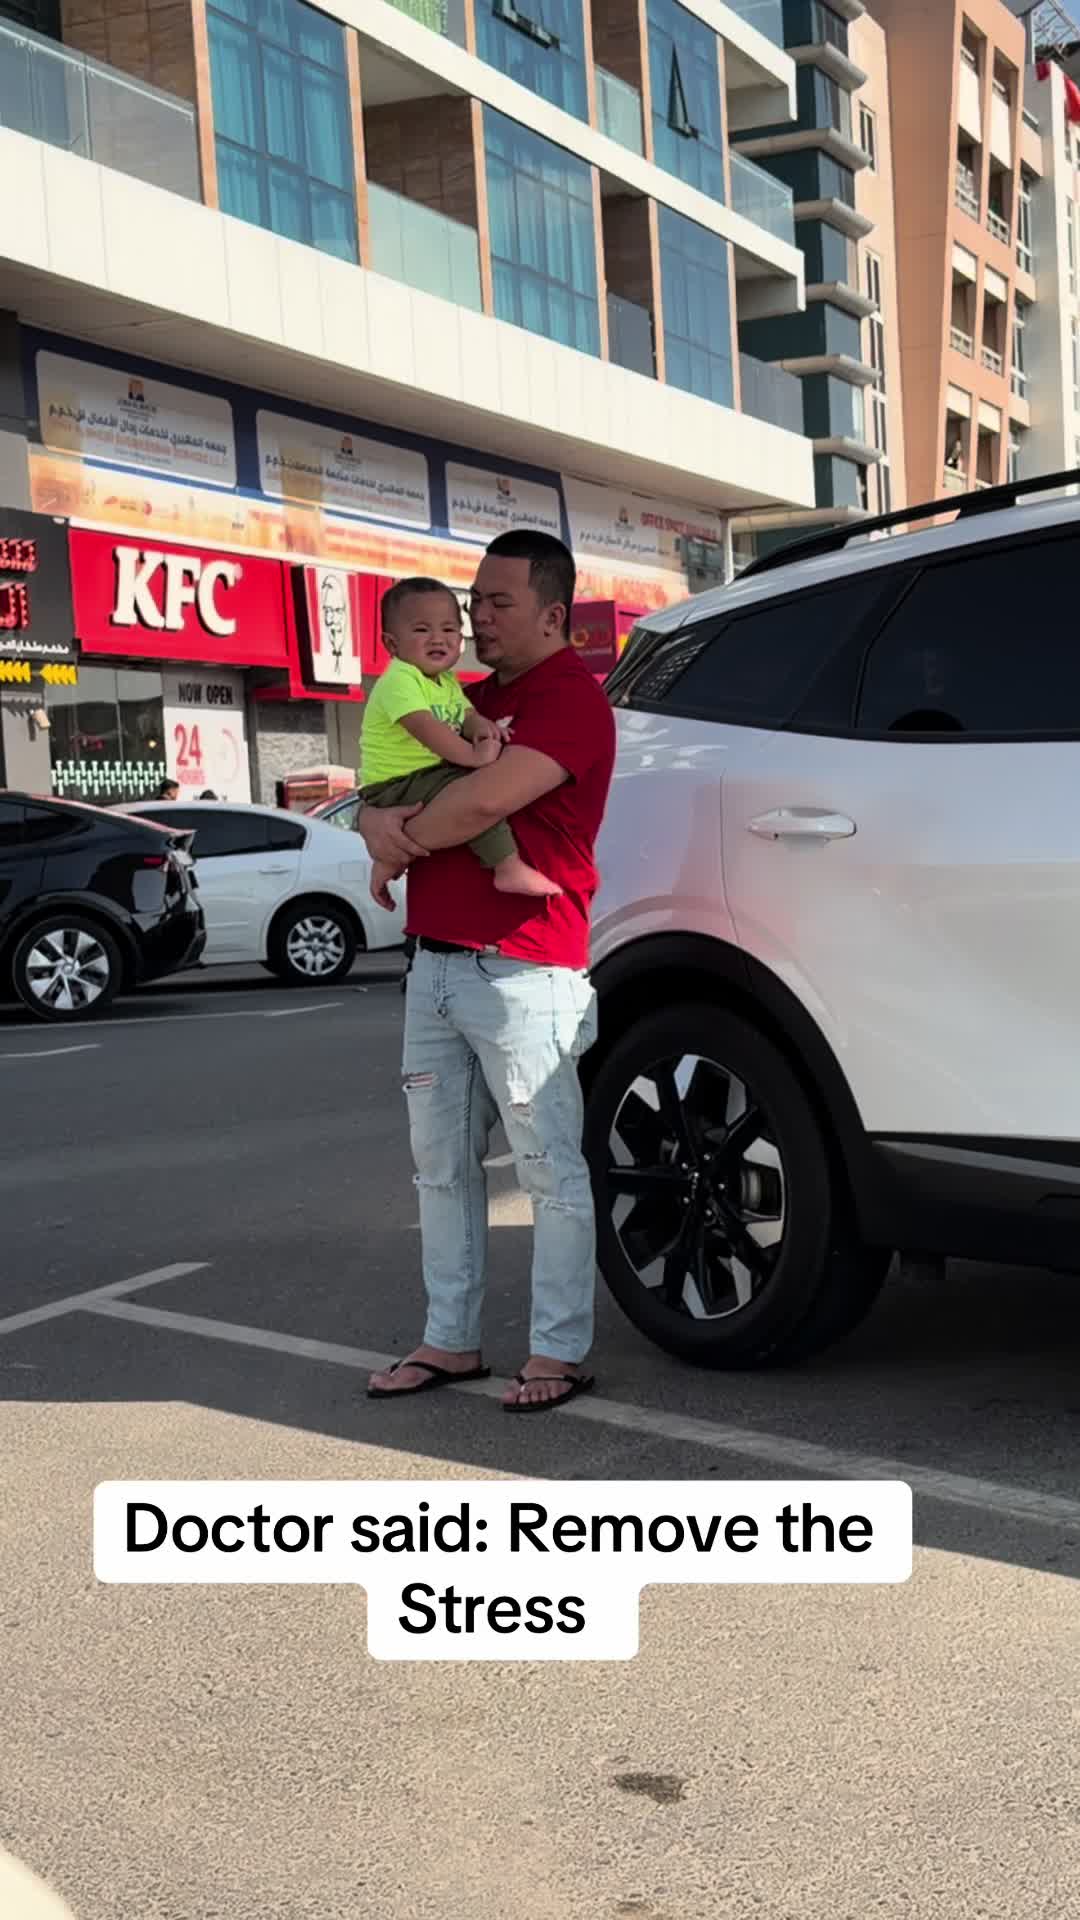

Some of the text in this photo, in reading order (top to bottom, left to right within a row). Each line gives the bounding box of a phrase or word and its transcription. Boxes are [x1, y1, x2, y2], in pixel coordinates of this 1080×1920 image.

[112, 545, 243, 636] KFC
[178, 682, 233, 705] NOW OPEN
[174, 723, 202, 768] 24
